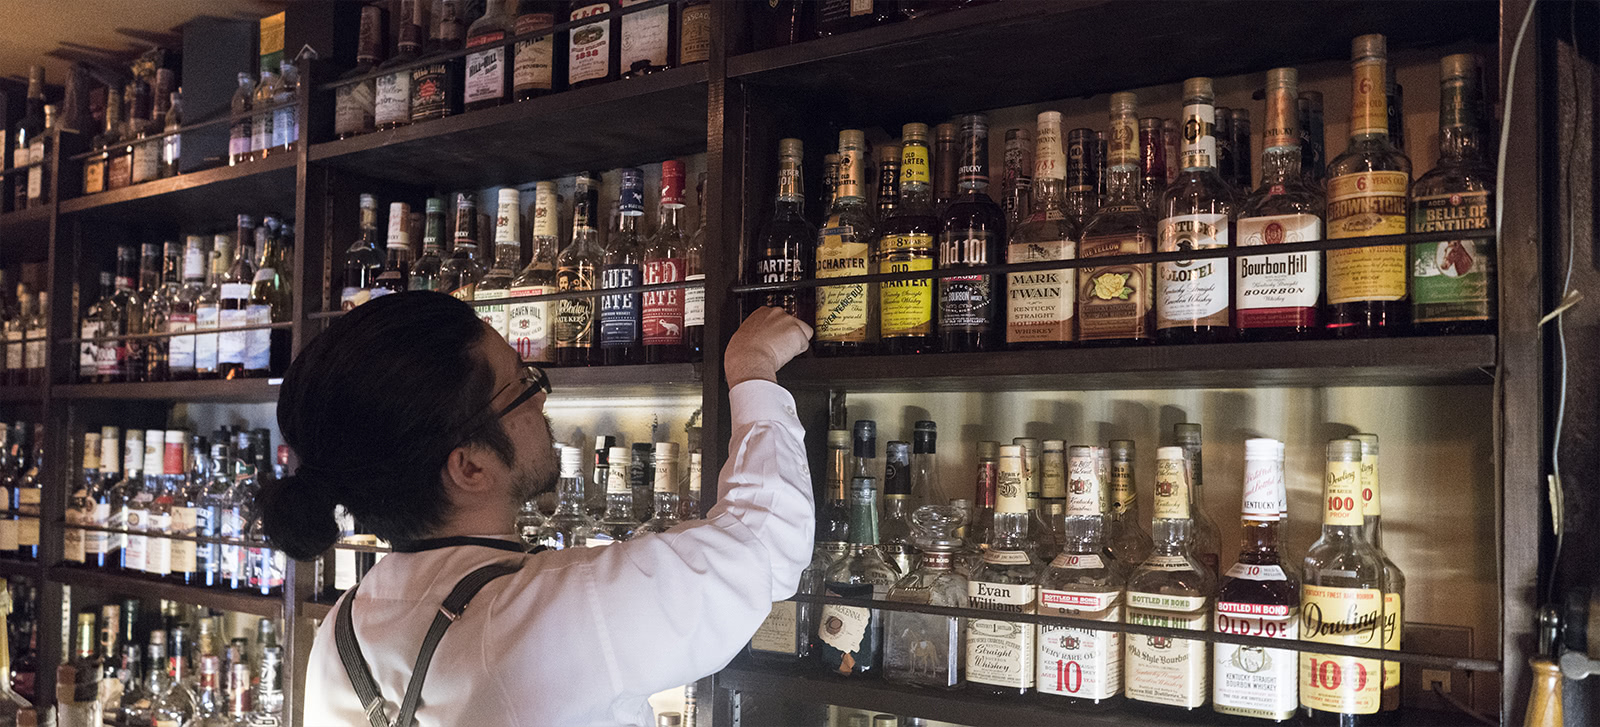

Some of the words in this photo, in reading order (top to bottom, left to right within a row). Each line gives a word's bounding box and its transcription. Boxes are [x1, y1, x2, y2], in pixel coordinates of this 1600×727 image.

[1359, 78, 1373, 95] 6
[904, 151, 915, 159] OLD
[905, 168, 912, 179] 8
[958, 165, 982, 175] ENTUCKY
[1356, 177, 1367, 191] 6
[1328, 196, 1406, 220] BROWNSTONE
[1426, 207, 1466, 221] BELLE
[1469, 204, 1488, 217] OF
[897, 237, 904, 247] 8
[939, 240, 959, 266] Old
[963, 238, 988, 264] 101
[1093, 244, 1119, 255] YELLOW
[823, 258, 866, 270] CHARTER
[891, 264, 909, 274] OLD
[1241, 255, 1286, 279] Bourbon
[1288, 254, 1307, 275] Hill
[602, 269, 633, 290] LUE
[1012, 273, 1058, 285] MARK
[949, 291, 970, 302] BOURBON
[1010, 287, 1061, 299] TWAIN
[1243, 287, 1305, 297] BOURBON
[820, 312, 838, 332] SEVEN
[833, 294, 855, 316] YEARS
[848, 283, 864, 301] OLD
[1013, 305, 1056, 313] KENTUCKY
[517, 336, 531, 360] 10
[1244, 501, 1275, 509] KENTUCKY
[1328, 496, 1354, 511] 100
[1067, 556, 1080, 565] 10
[1248, 566, 1260, 576] 10
[977, 583, 1011, 598] Evan
[1327, 591, 1342, 599] FINEST
[970, 596, 1023, 613] Williams
[1132, 595, 1161, 604] BOTTLED
[1218, 603, 1251, 613] BOTTLED
[1252, 605, 1261, 613] IN
[1263, 606, 1287, 615] BOND
[1129, 612, 1169, 628] HEAVEN
[1218, 614, 1250, 635] OLD
[1253, 617, 1287, 638] JOE
[1303, 601, 1377, 645] Dowling
[975, 644, 1012, 657] Straight
[1041, 645, 1059, 658] VERY
[1061, 653, 1082, 661] RARE
[975, 655, 1009, 672] Whiskey
[1142, 651, 1159, 664] Style
[1056, 659, 1082, 694] 10
[1226, 673, 1250, 681] KENTUCKY
[1309, 657, 1367, 692] 100
[1226, 680, 1251, 688] BOURBON
